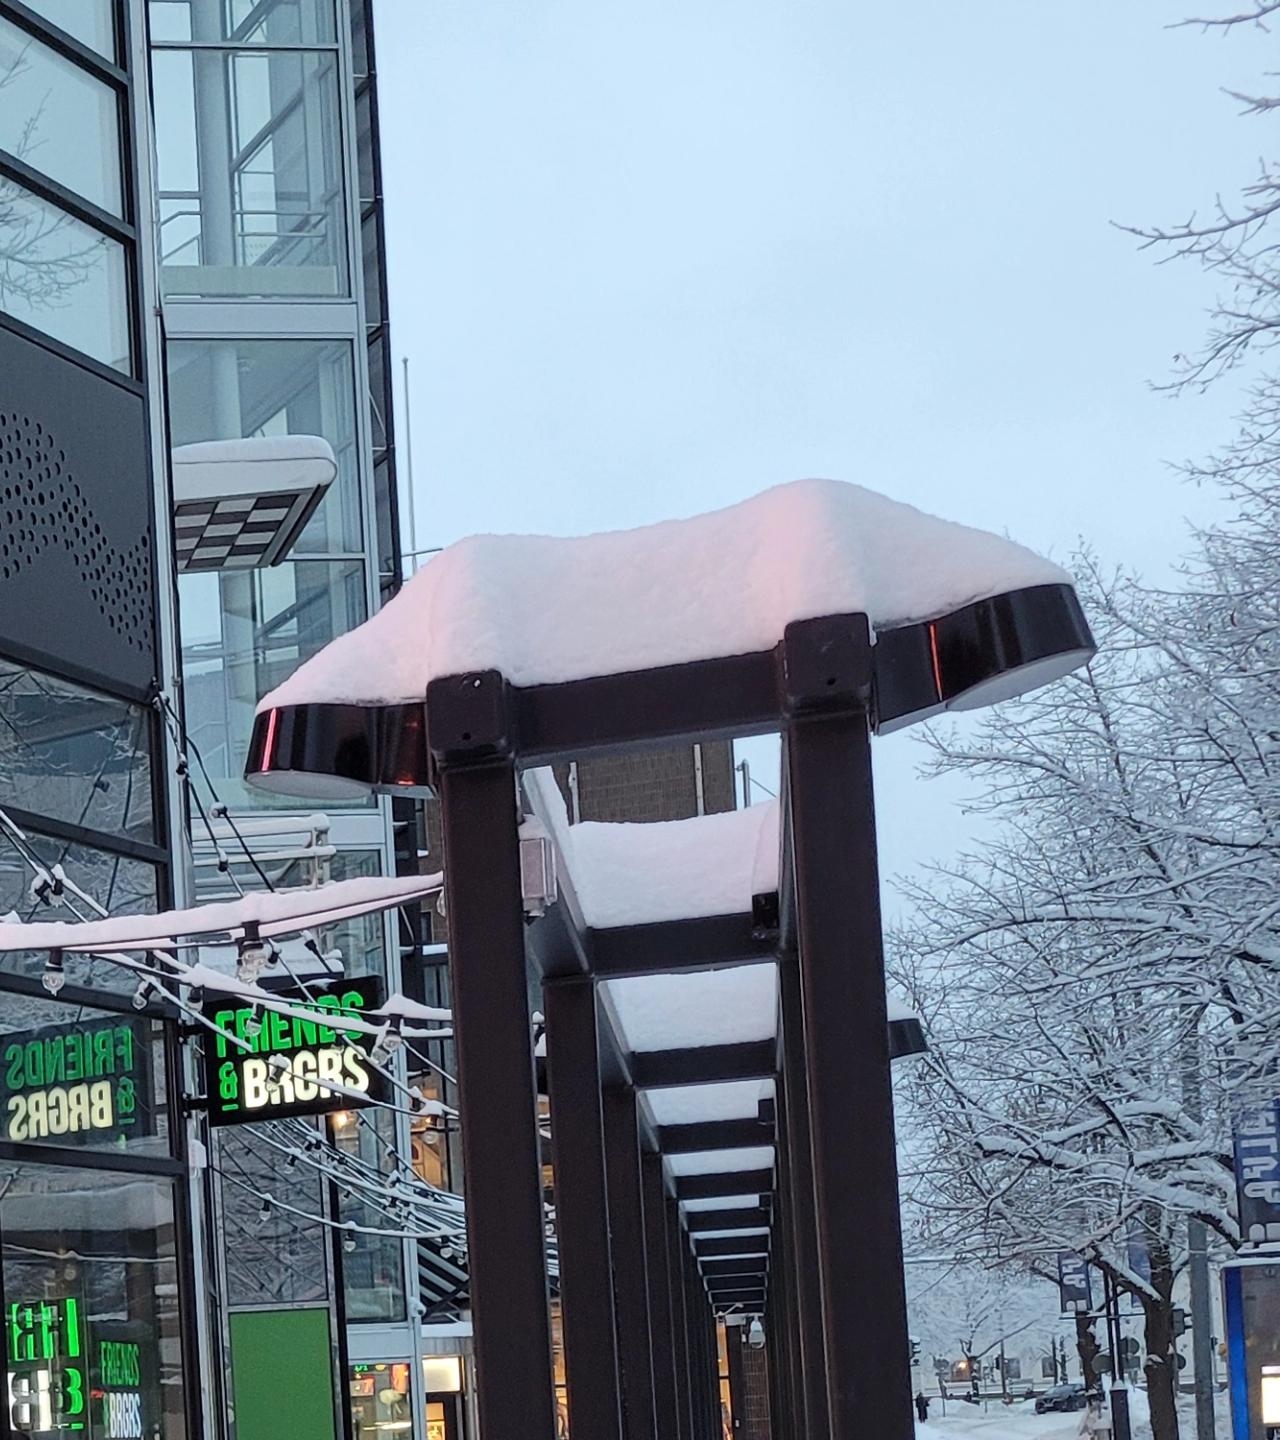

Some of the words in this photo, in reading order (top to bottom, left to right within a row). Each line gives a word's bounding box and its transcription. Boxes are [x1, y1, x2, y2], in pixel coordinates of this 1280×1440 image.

[215, 990, 365, 1058] FRIENDS
[219, 1061, 239, 1111] &
[242, 1046, 369, 1108] BRGRS
